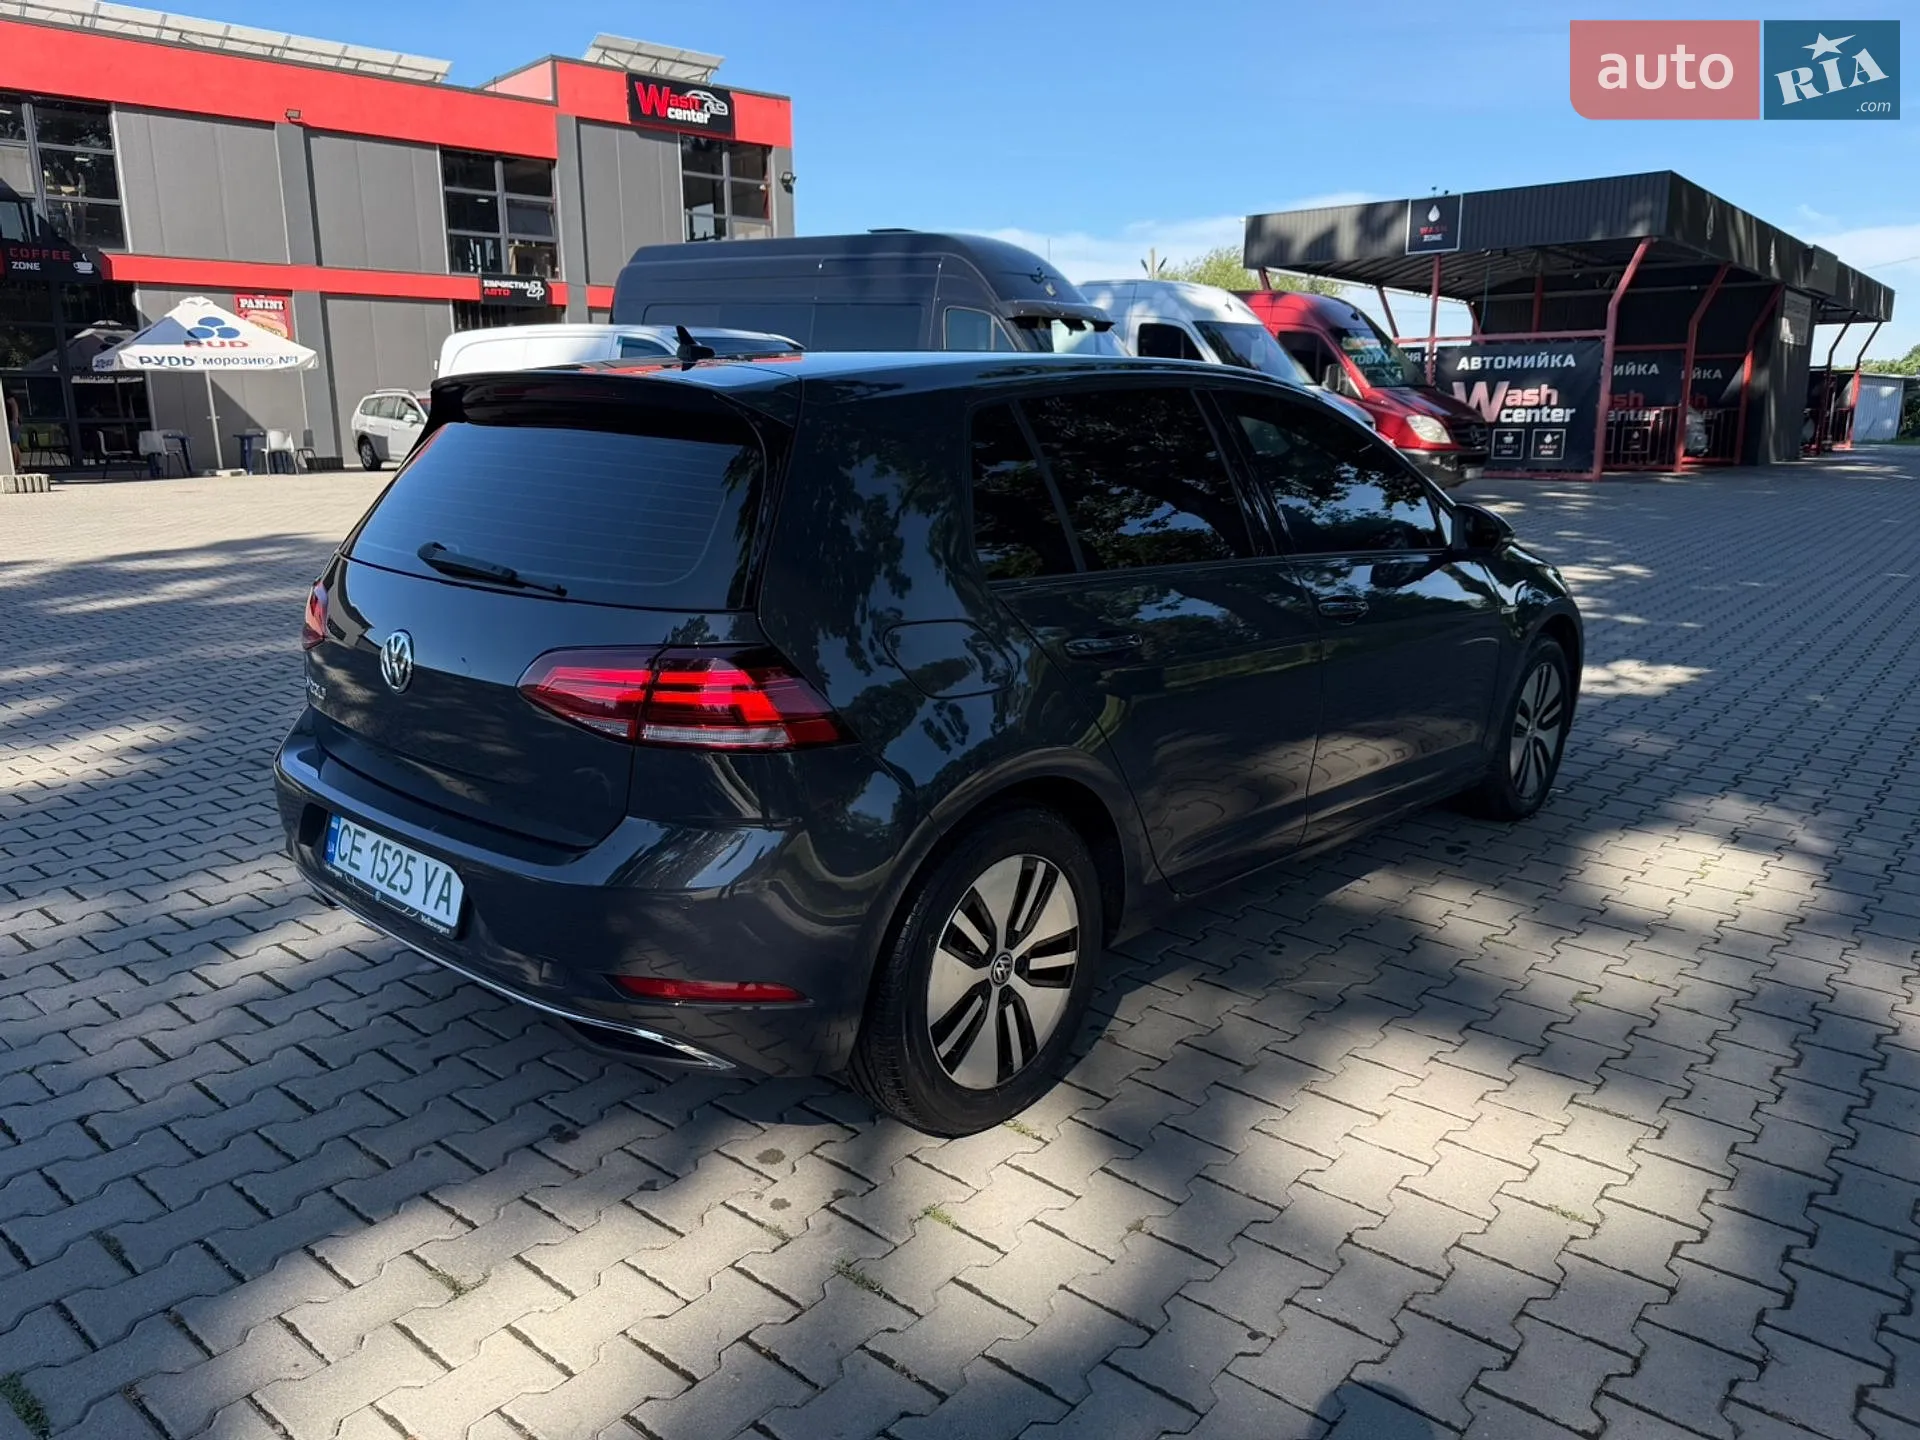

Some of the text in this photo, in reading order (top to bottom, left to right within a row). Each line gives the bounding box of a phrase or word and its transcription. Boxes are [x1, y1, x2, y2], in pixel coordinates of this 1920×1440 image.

[634, 80, 701, 118] Wash
[667, 107, 711, 125] center
[9, 247, 71, 261] COFFEE
[11, 261, 41, 271] ZONE
[484, 288, 511, 296] АВТО
[239, 297, 285, 311] PANINI
[184, 339, 249, 348] RUD
[139, 355, 196, 367] РУДЬ
[202, 356, 274, 366] морозиво
[1456, 351, 1577, 371] АВТОМИЙКА
[1604, 361, 1660, 376] ИЙКА
[1682, 366, 1723, 380] ЙКА
[1451, 380, 1559, 423] Wash
[1500, 404, 1576, 424] center
[337, 823, 453, 916] CE 1525 YA
